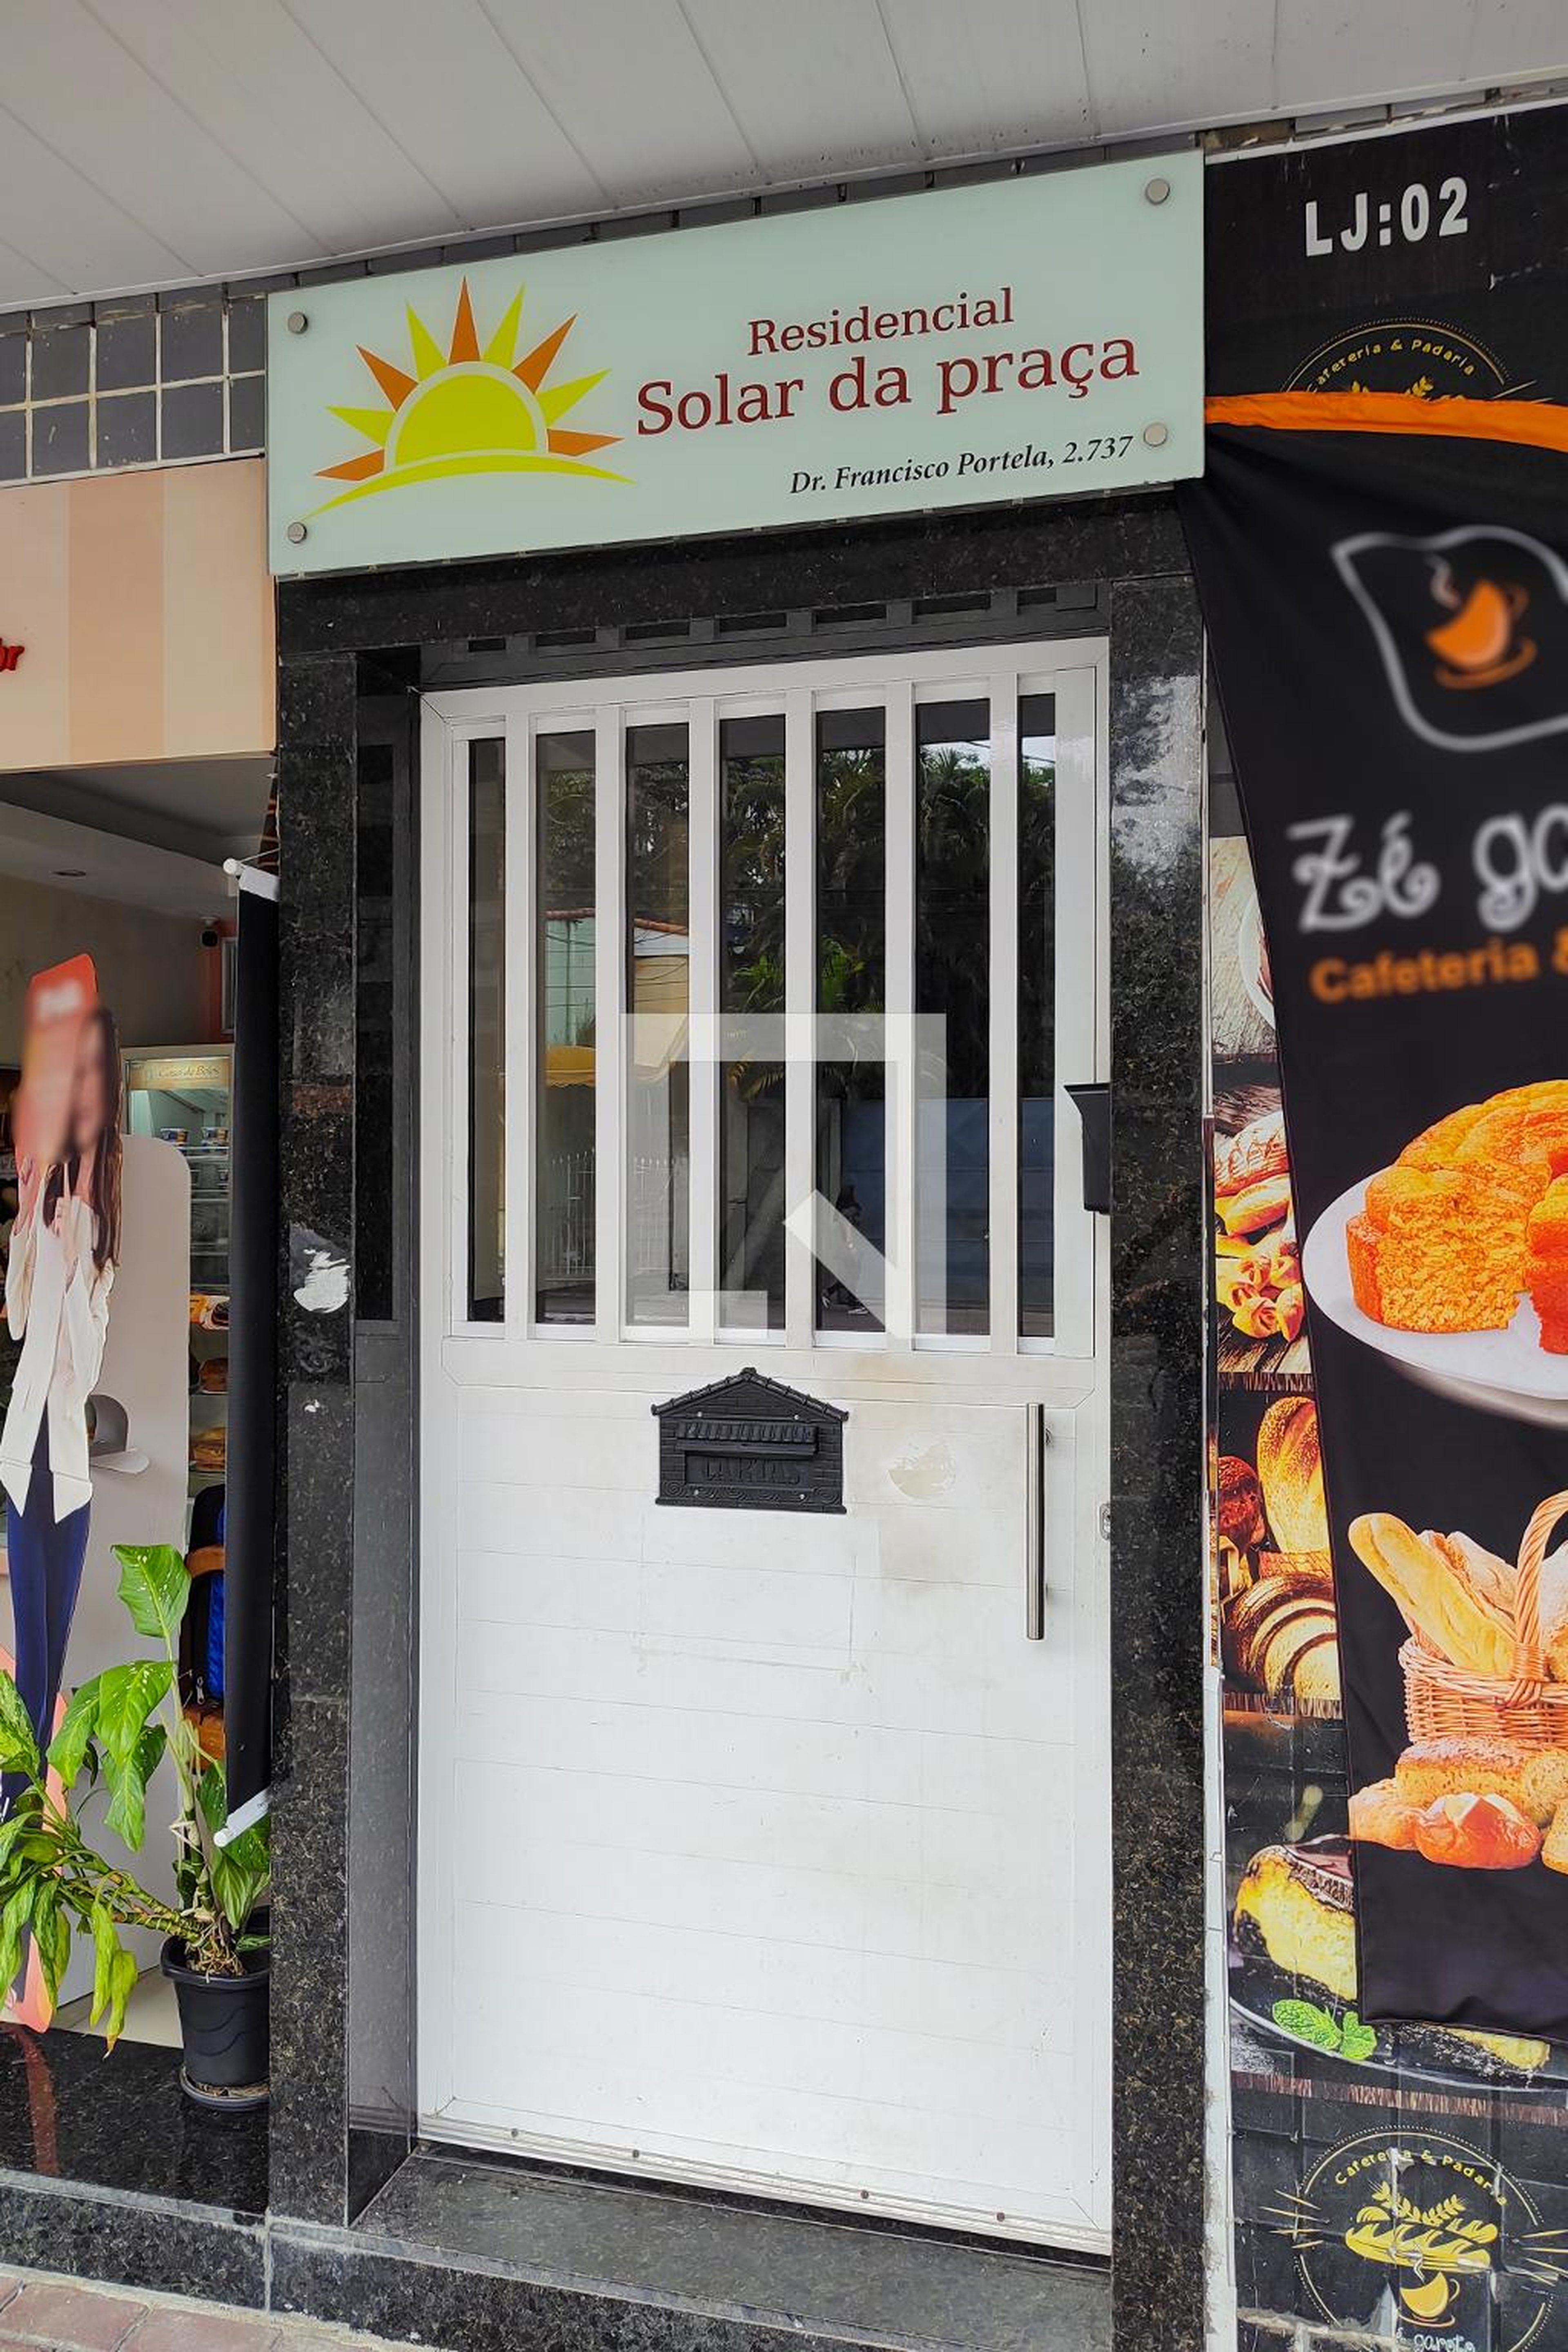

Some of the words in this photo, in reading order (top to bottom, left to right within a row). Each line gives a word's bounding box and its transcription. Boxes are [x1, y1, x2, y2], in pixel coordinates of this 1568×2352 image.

[1306, 177, 1468, 257] LJ:02
[748, 287, 1015, 355] Residencial
[636, 372, 804, 436] Solar
[829, 356, 912, 412] da
[937, 336, 1139, 415] praça
[1391, 339, 1403, 351] &
[1412, 339, 1475, 375] Padaria
[791, 472, 826, 494] Dr.
[835, 459, 950, 489] Francisco
[958, 444, 1054, 476] Portela,
[1062, 436, 1134, 463] 2.737
[1311, 938, 1539, 1002] Cafeteria
